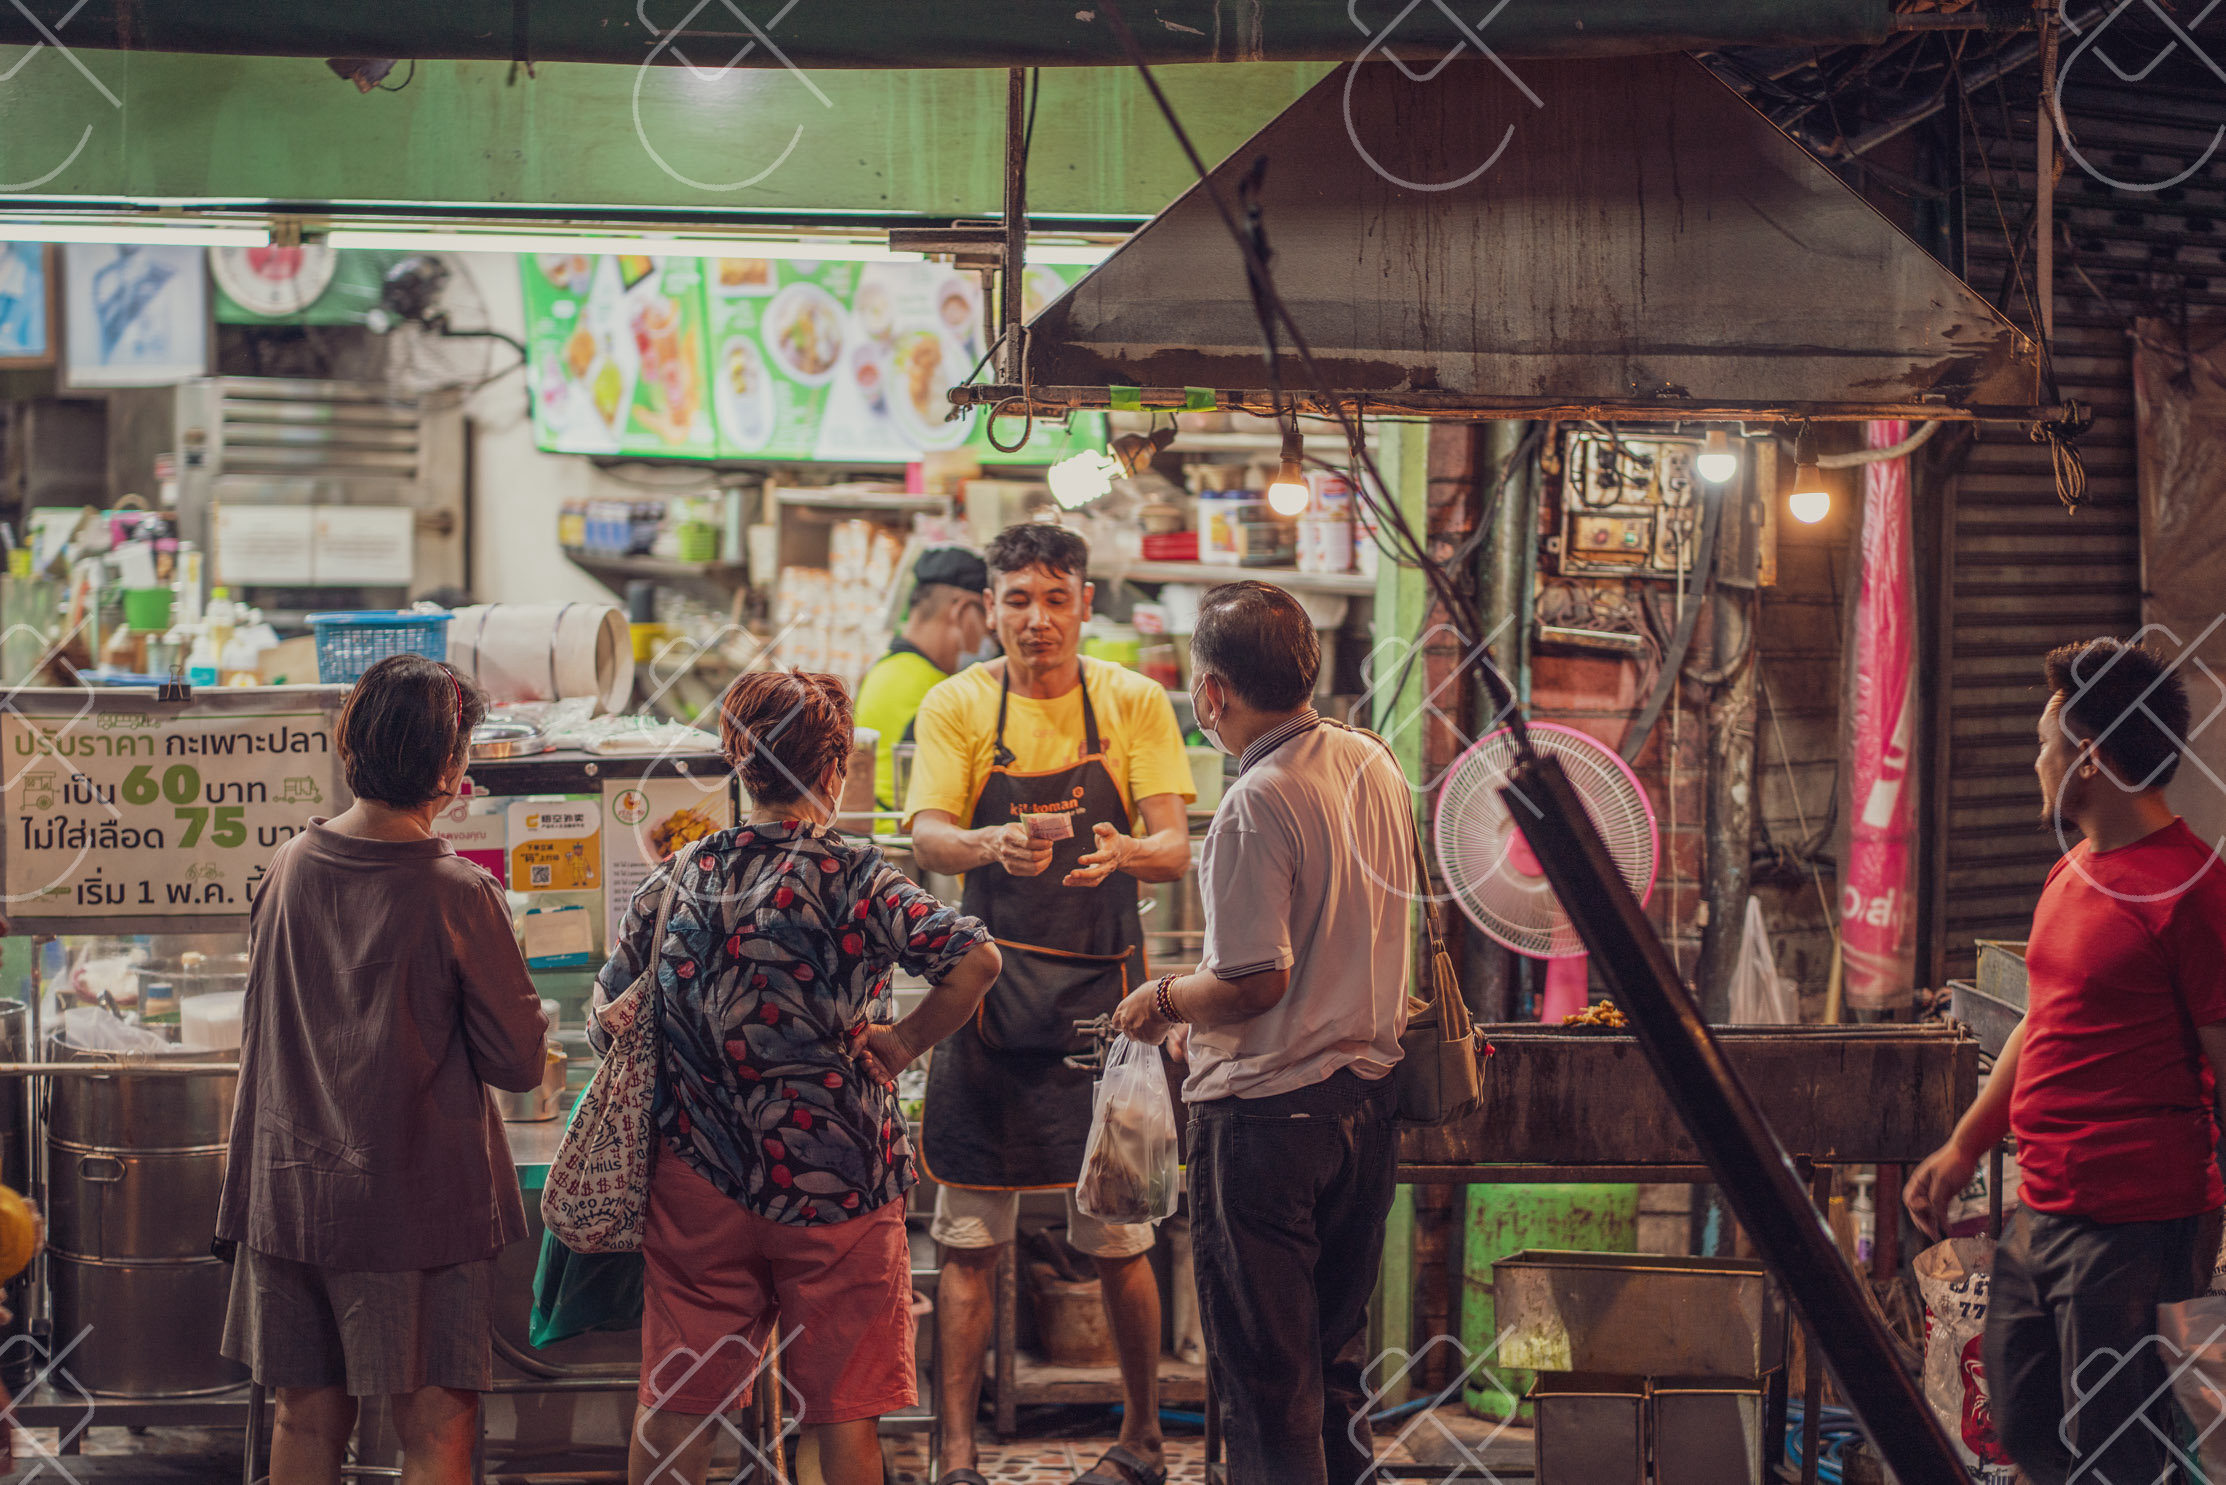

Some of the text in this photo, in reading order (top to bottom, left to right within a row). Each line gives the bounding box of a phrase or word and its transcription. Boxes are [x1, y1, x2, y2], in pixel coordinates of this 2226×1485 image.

[15, 726, 328, 757] ปรับราคา กะเพาะปลา
[63, 764, 267, 806] เป็น 60 บาท
[20, 806, 306, 850] ไม่ใส่เลือด 75 บา
[77, 867, 126, 905] เริ่ม
[138, 880, 155, 904] 1
[166, 882, 235, 904] พ.ค.
